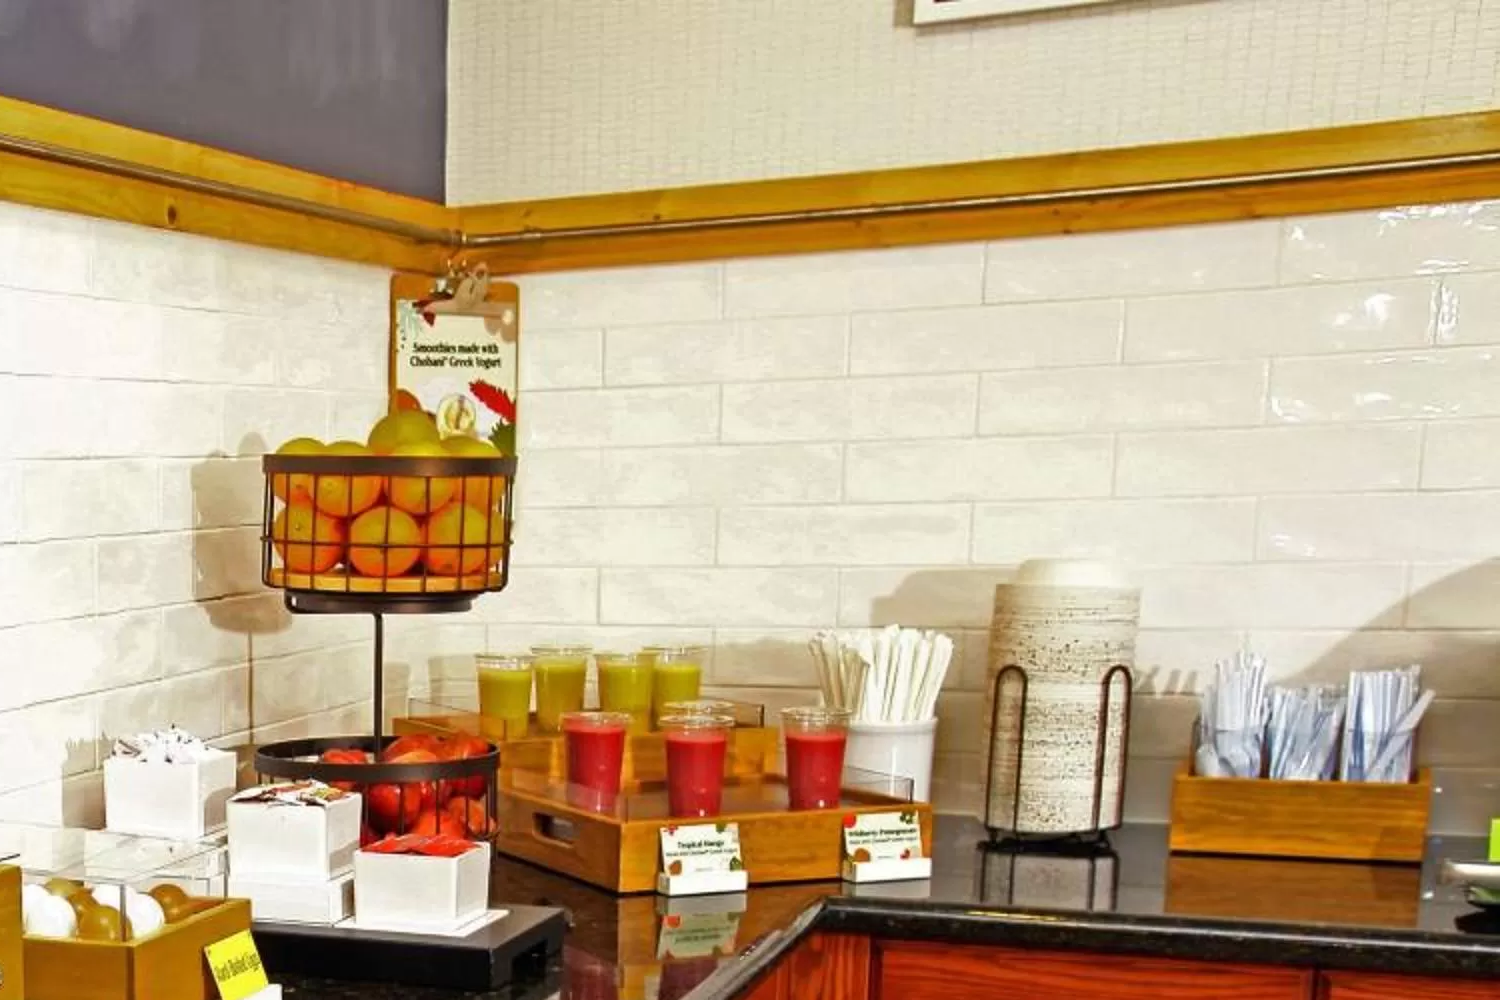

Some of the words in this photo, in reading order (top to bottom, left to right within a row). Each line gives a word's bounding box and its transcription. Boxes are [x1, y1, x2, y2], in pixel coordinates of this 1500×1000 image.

[412, 342, 456, 354] Smoothies
[457, 343, 479, 354] made
[481, 343, 499, 354] with
[449, 356, 474, 368] Greek
[475, 356, 502, 370] Yogurt
